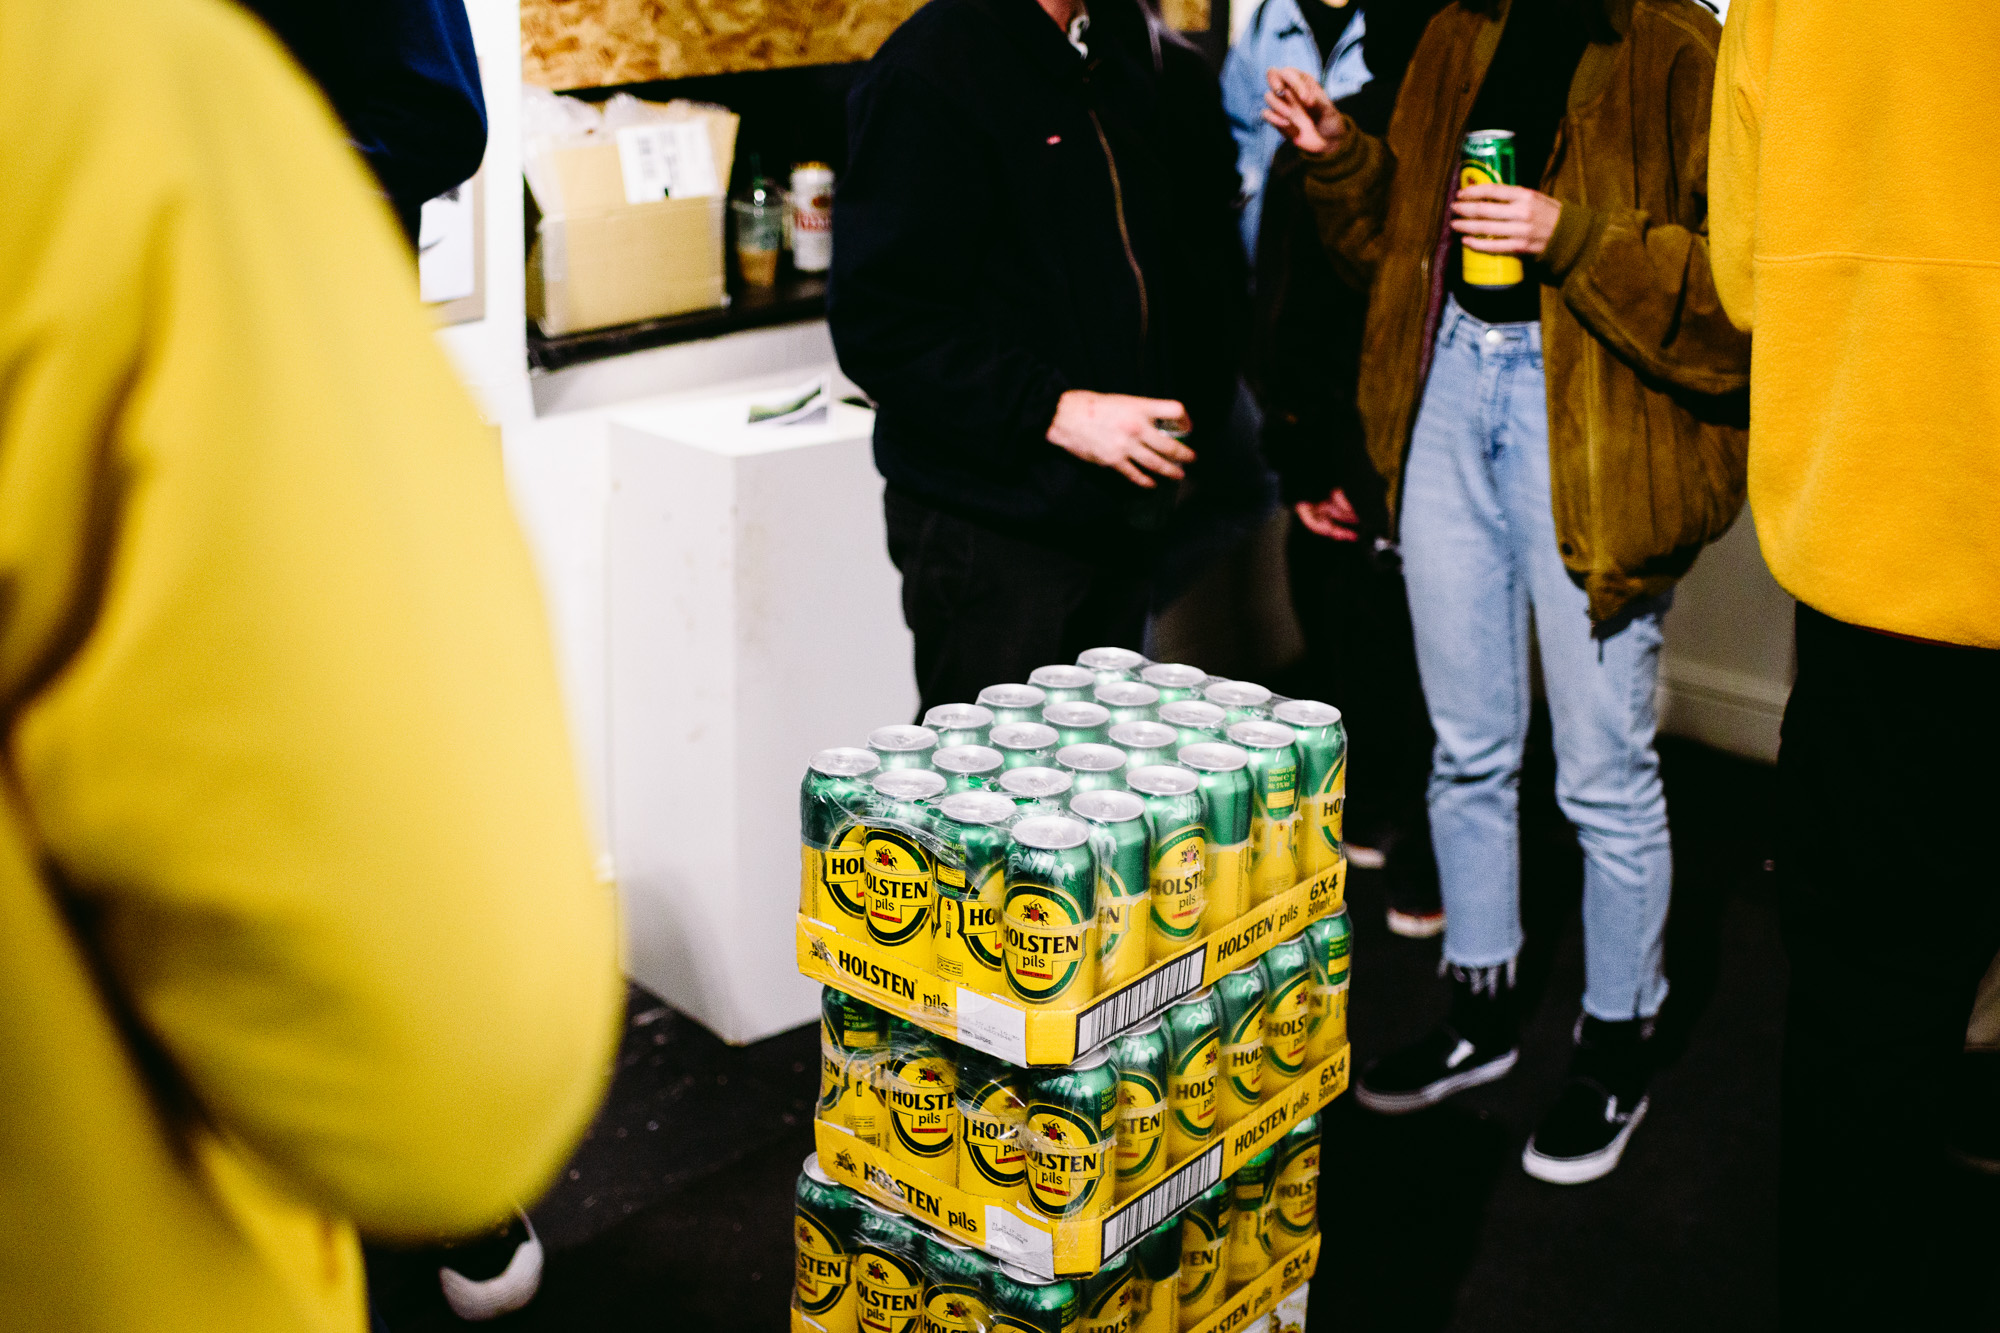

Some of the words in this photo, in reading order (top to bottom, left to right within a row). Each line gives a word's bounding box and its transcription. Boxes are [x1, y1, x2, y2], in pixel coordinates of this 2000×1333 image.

[1310, 873, 1338, 900] 6X4
[875, 897, 895, 912] pils
[1178, 893, 1196, 912] pils
[1217, 914, 1274, 963] HOLSTEN
[1279, 904, 1299, 932] pils
[1022, 954, 1046, 969] pils
[839, 949, 915, 1000] HOLSTEN
[1320, 1056, 1345, 1085] 6X4
[918, 1113, 941, 1127] pils
[1234, 1103, 1288, 1156] HOLSTEN
[1041, 1170, 1063, 1185] pils
[948, 1210, 977, 1232] pils
[866, 1308, 885, 1321] pils
